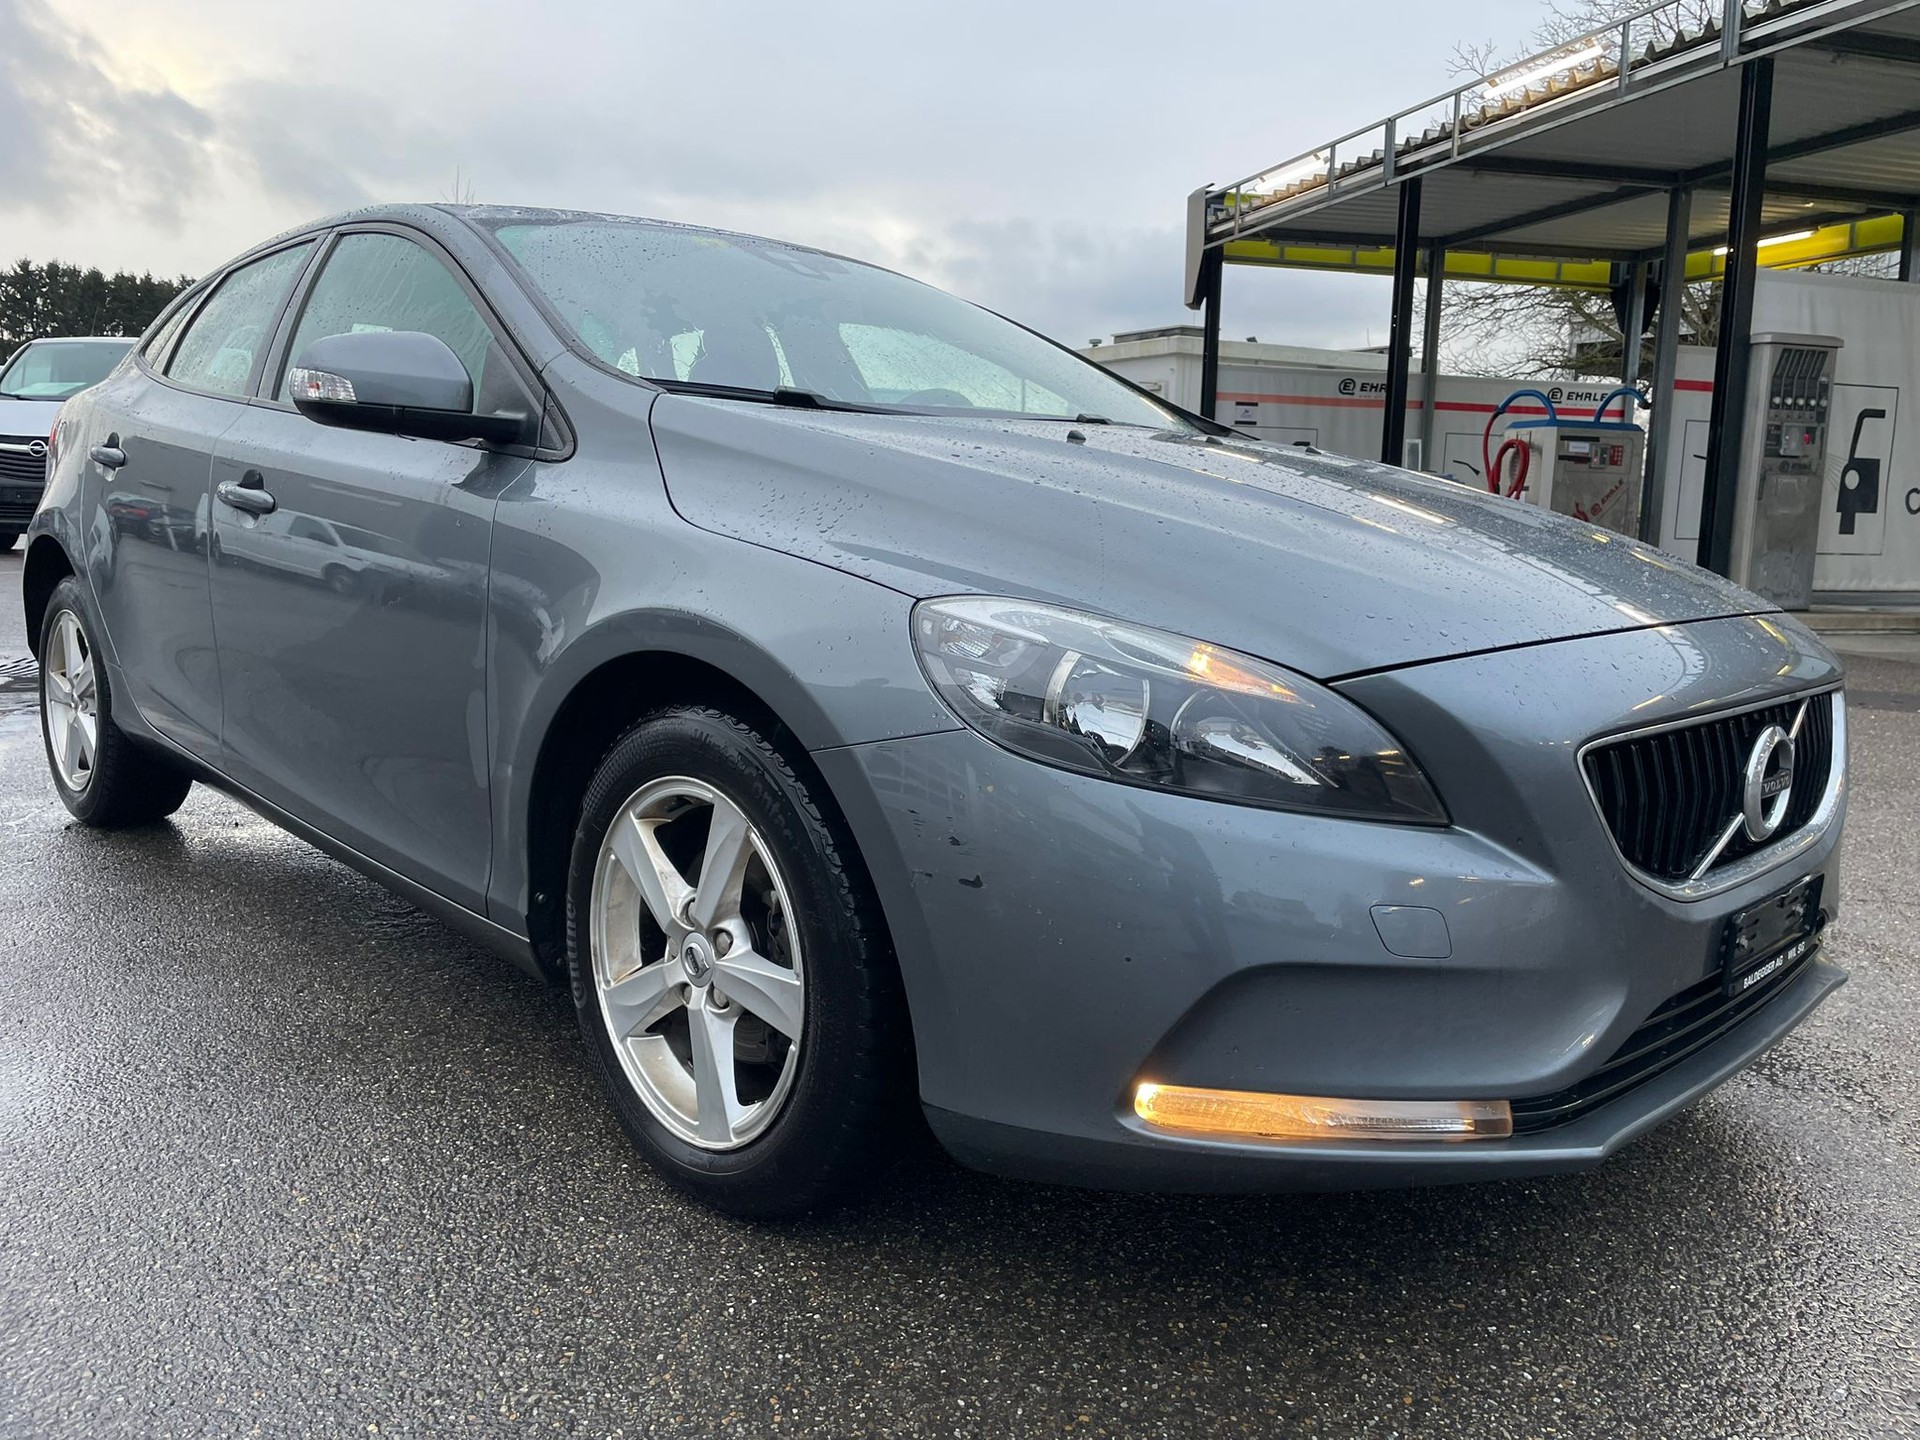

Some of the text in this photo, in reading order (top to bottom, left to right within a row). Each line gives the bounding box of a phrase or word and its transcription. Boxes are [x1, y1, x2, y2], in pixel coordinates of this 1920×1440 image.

[1360, 382, 1387, 393] EHR
[1566, 391, 1608, 402] EHRLE
[1743, 960, 1775, 989] BALDEGGER
[1775, 954, 1783, 969] AG
